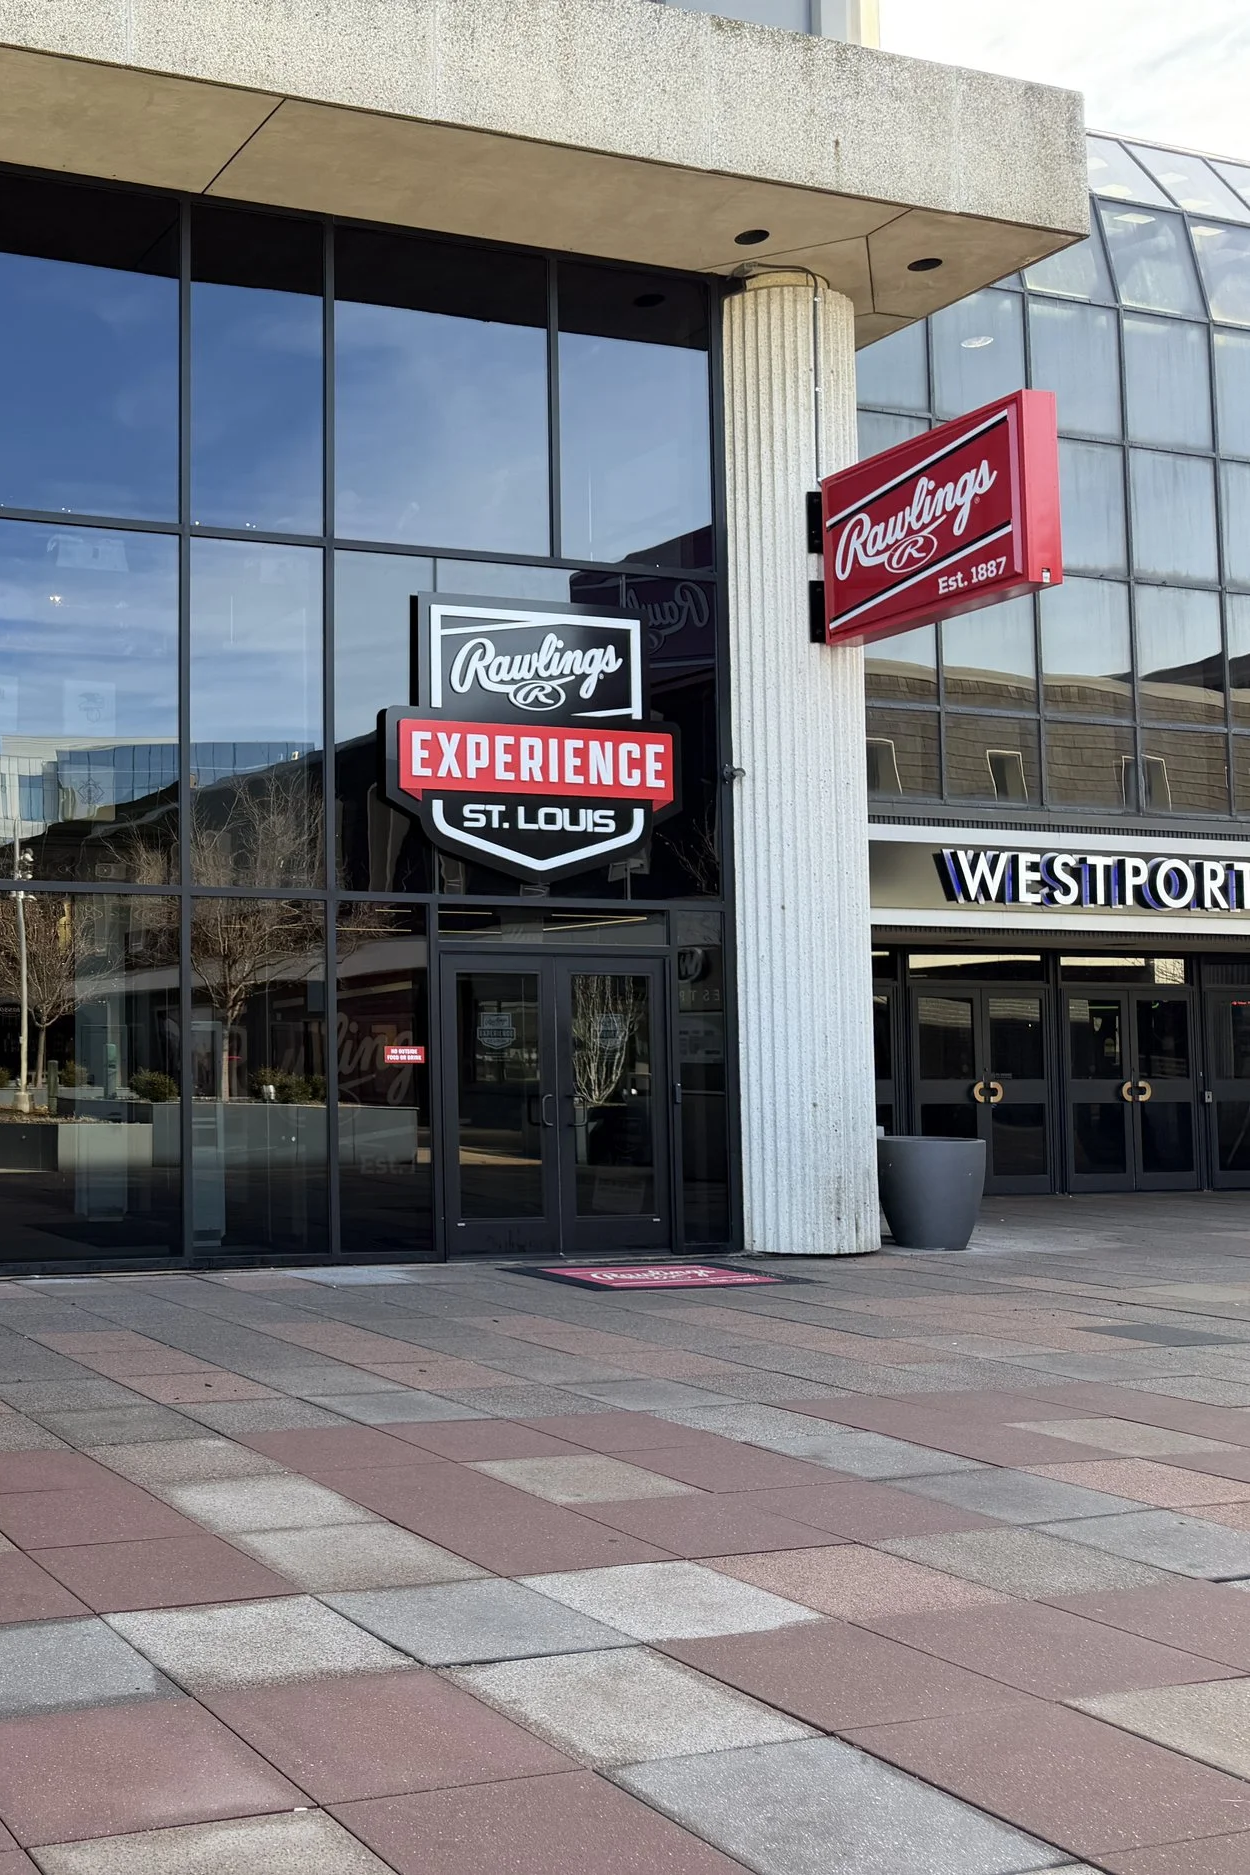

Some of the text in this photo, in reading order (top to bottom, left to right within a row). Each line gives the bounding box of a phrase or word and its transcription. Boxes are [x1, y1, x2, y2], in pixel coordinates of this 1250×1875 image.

[835, 459, 998, 581] Rawlings
[938, 555, 1008, 596] Est. 1887
[449, 632, 624, 700] Rawlings
[410, 730, 667, 789] EXPERIENCE
[462, 803, 617, 834] ST. LOUIS
[943, 847, 1250, 912] WESTPORT
